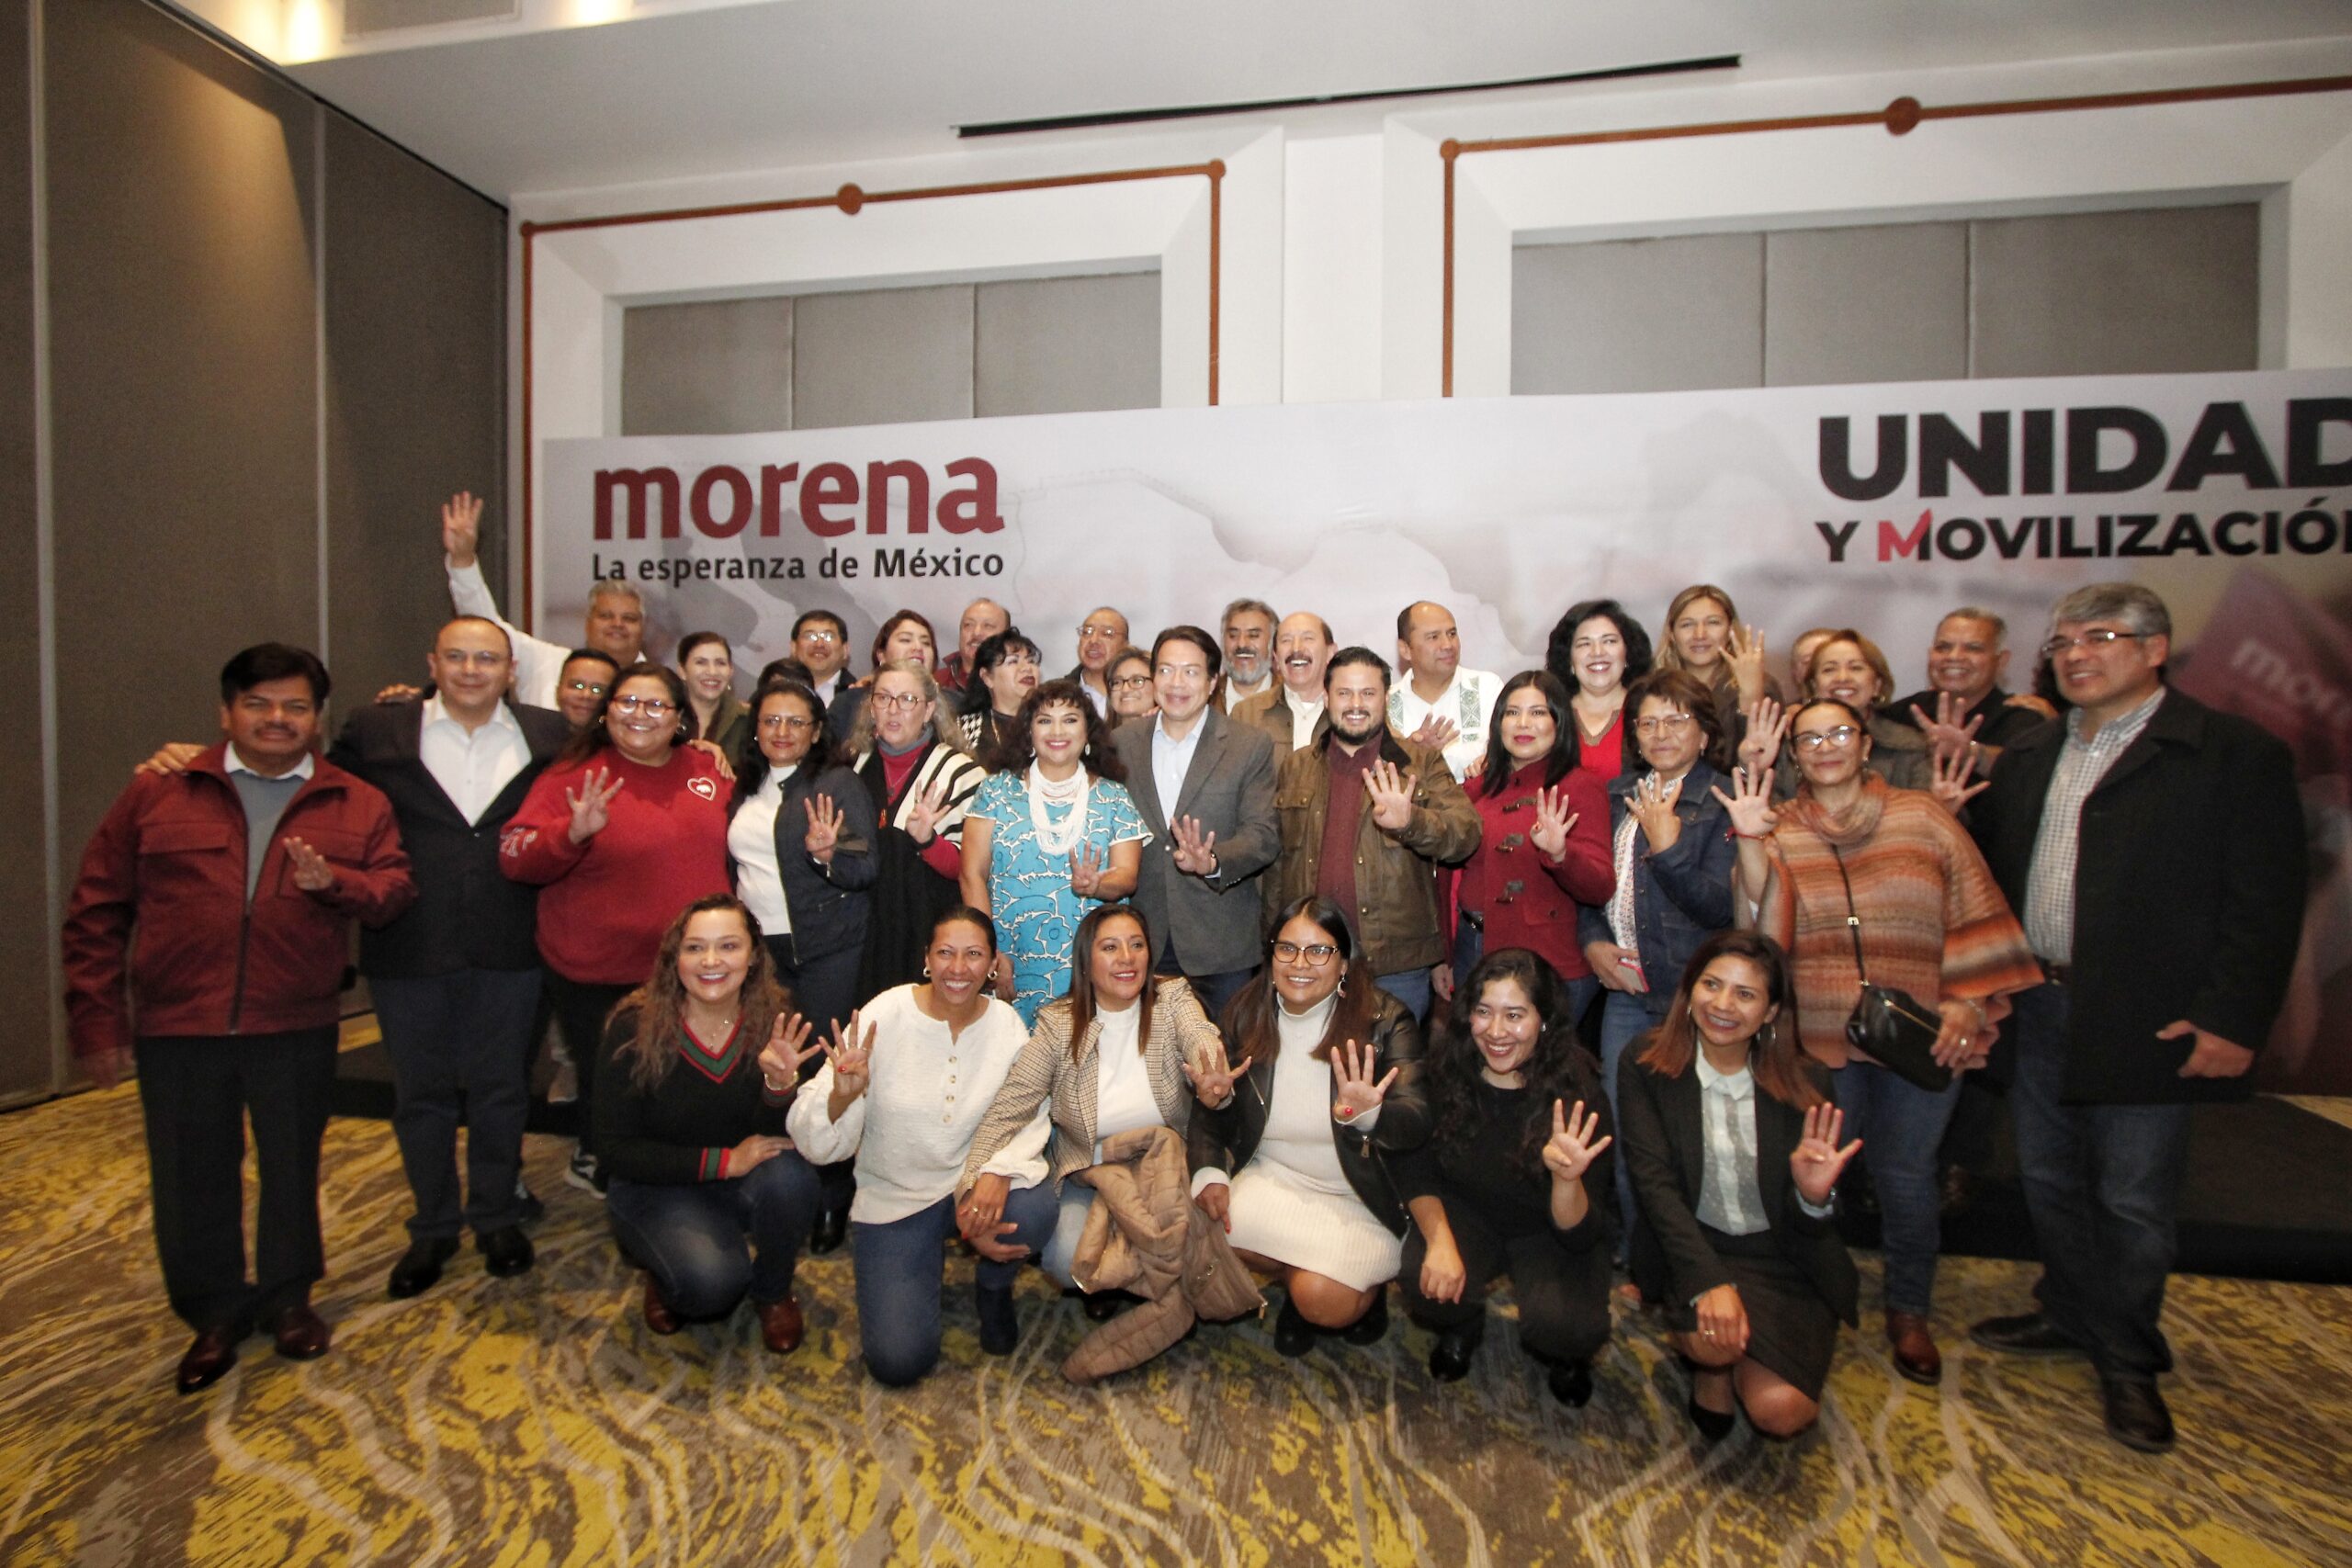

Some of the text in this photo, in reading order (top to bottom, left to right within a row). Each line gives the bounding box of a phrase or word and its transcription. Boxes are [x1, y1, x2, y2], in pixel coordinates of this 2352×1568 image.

[1819, 398, 2352, 502] UNIDAD
[593, 457, 1005, 541] morena
[1815, 496, 2352, 562] Y MOVILIZACIÓ
[593, 547, 1004, 589] La esperanza de México
